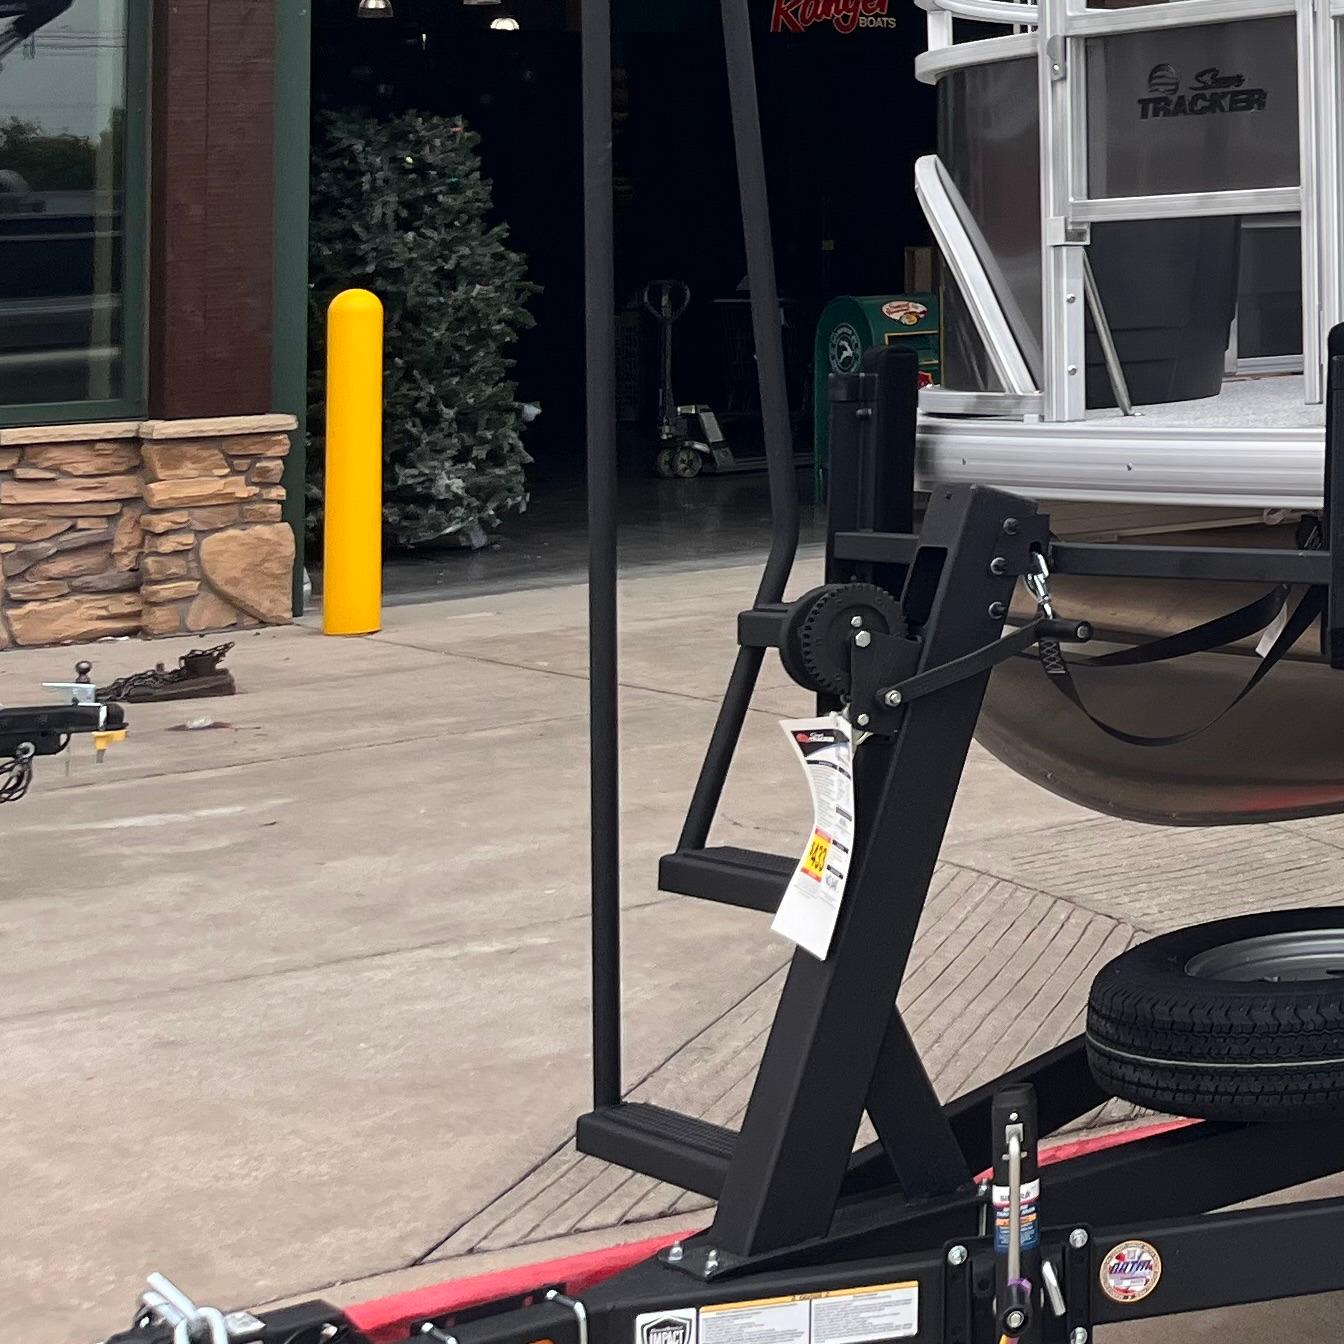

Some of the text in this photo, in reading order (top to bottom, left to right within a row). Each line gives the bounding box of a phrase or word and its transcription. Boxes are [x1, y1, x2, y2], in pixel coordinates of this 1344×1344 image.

[859, 16, 897, 29] BOATS
[1187, 67, 1246, 91] Sun
[1138, 88, 1268, 119] TRACKER
